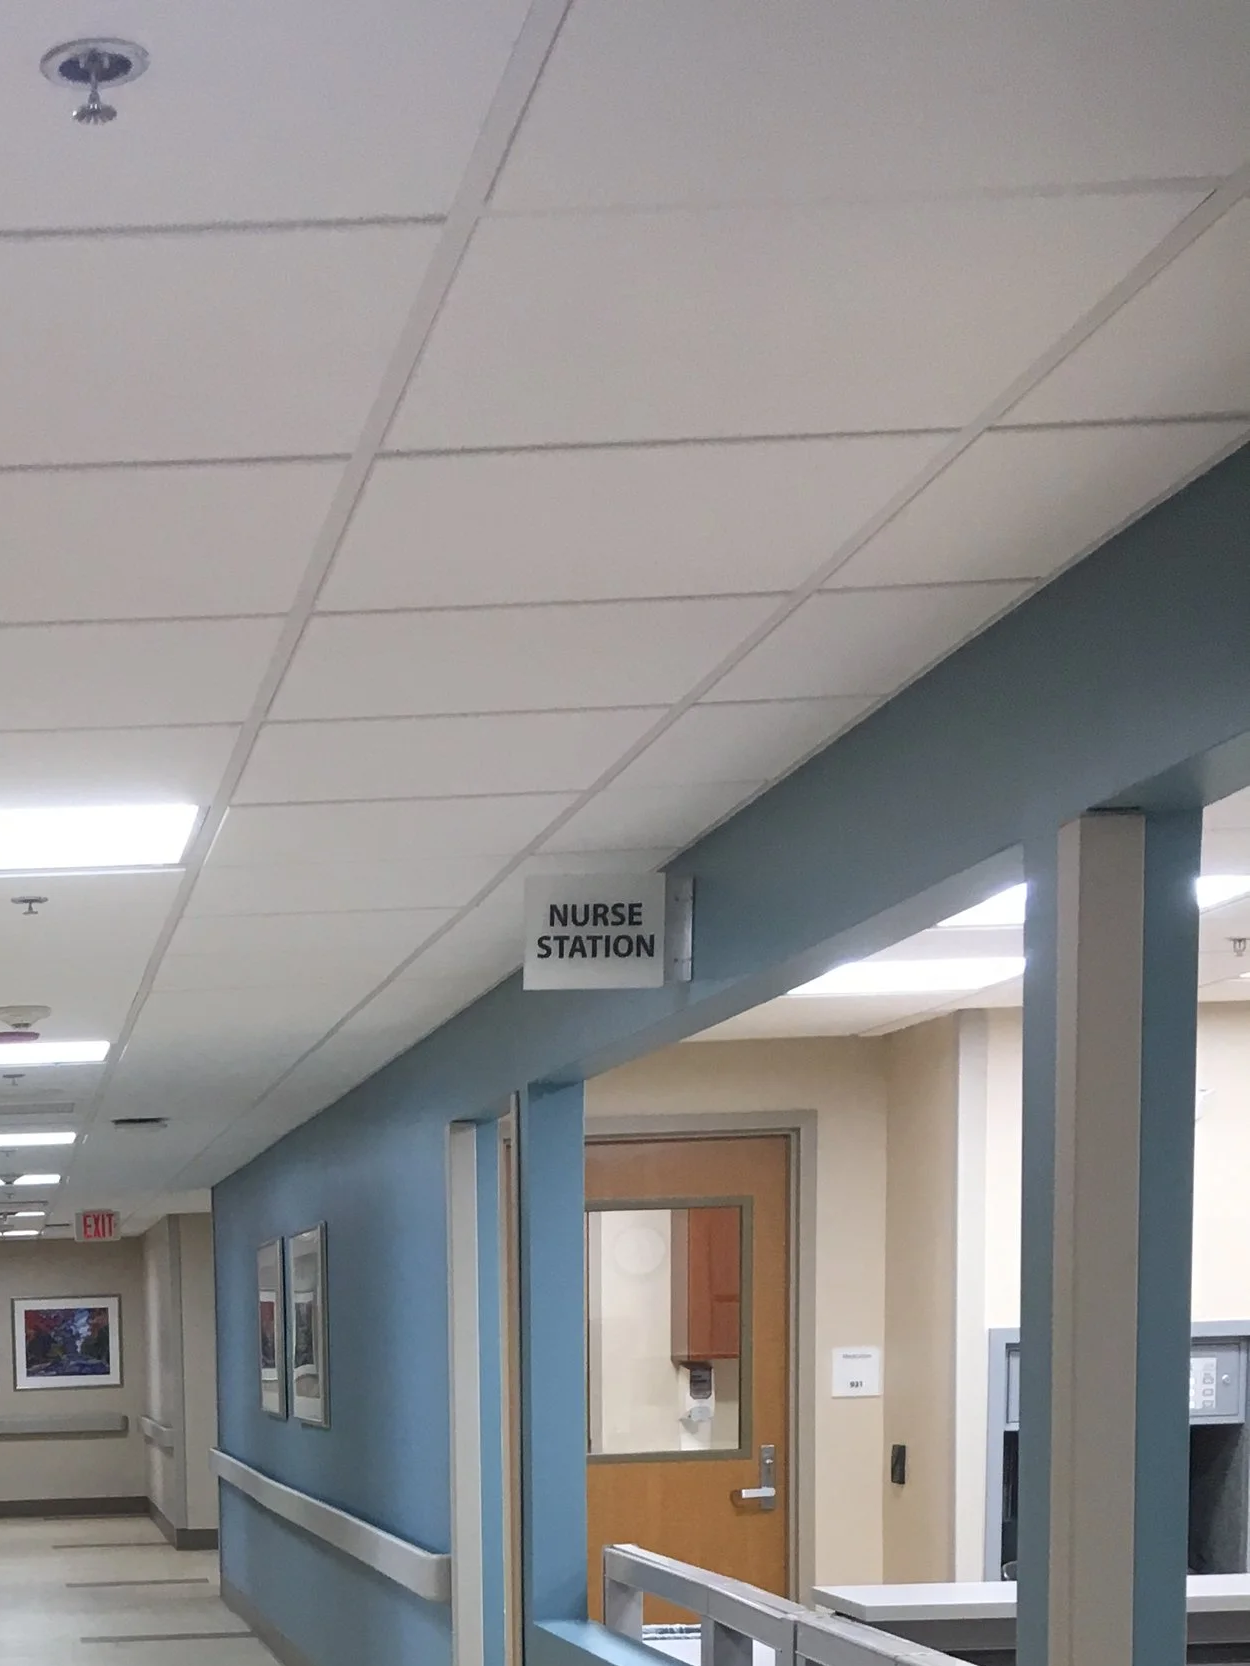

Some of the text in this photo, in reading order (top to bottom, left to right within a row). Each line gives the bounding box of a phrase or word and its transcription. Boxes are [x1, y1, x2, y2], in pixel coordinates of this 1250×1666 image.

[549, 902, 643, 927] NURSE
[536, 934, 655, 959] STATION
[83, 1213, 114, 1239] EXIT
